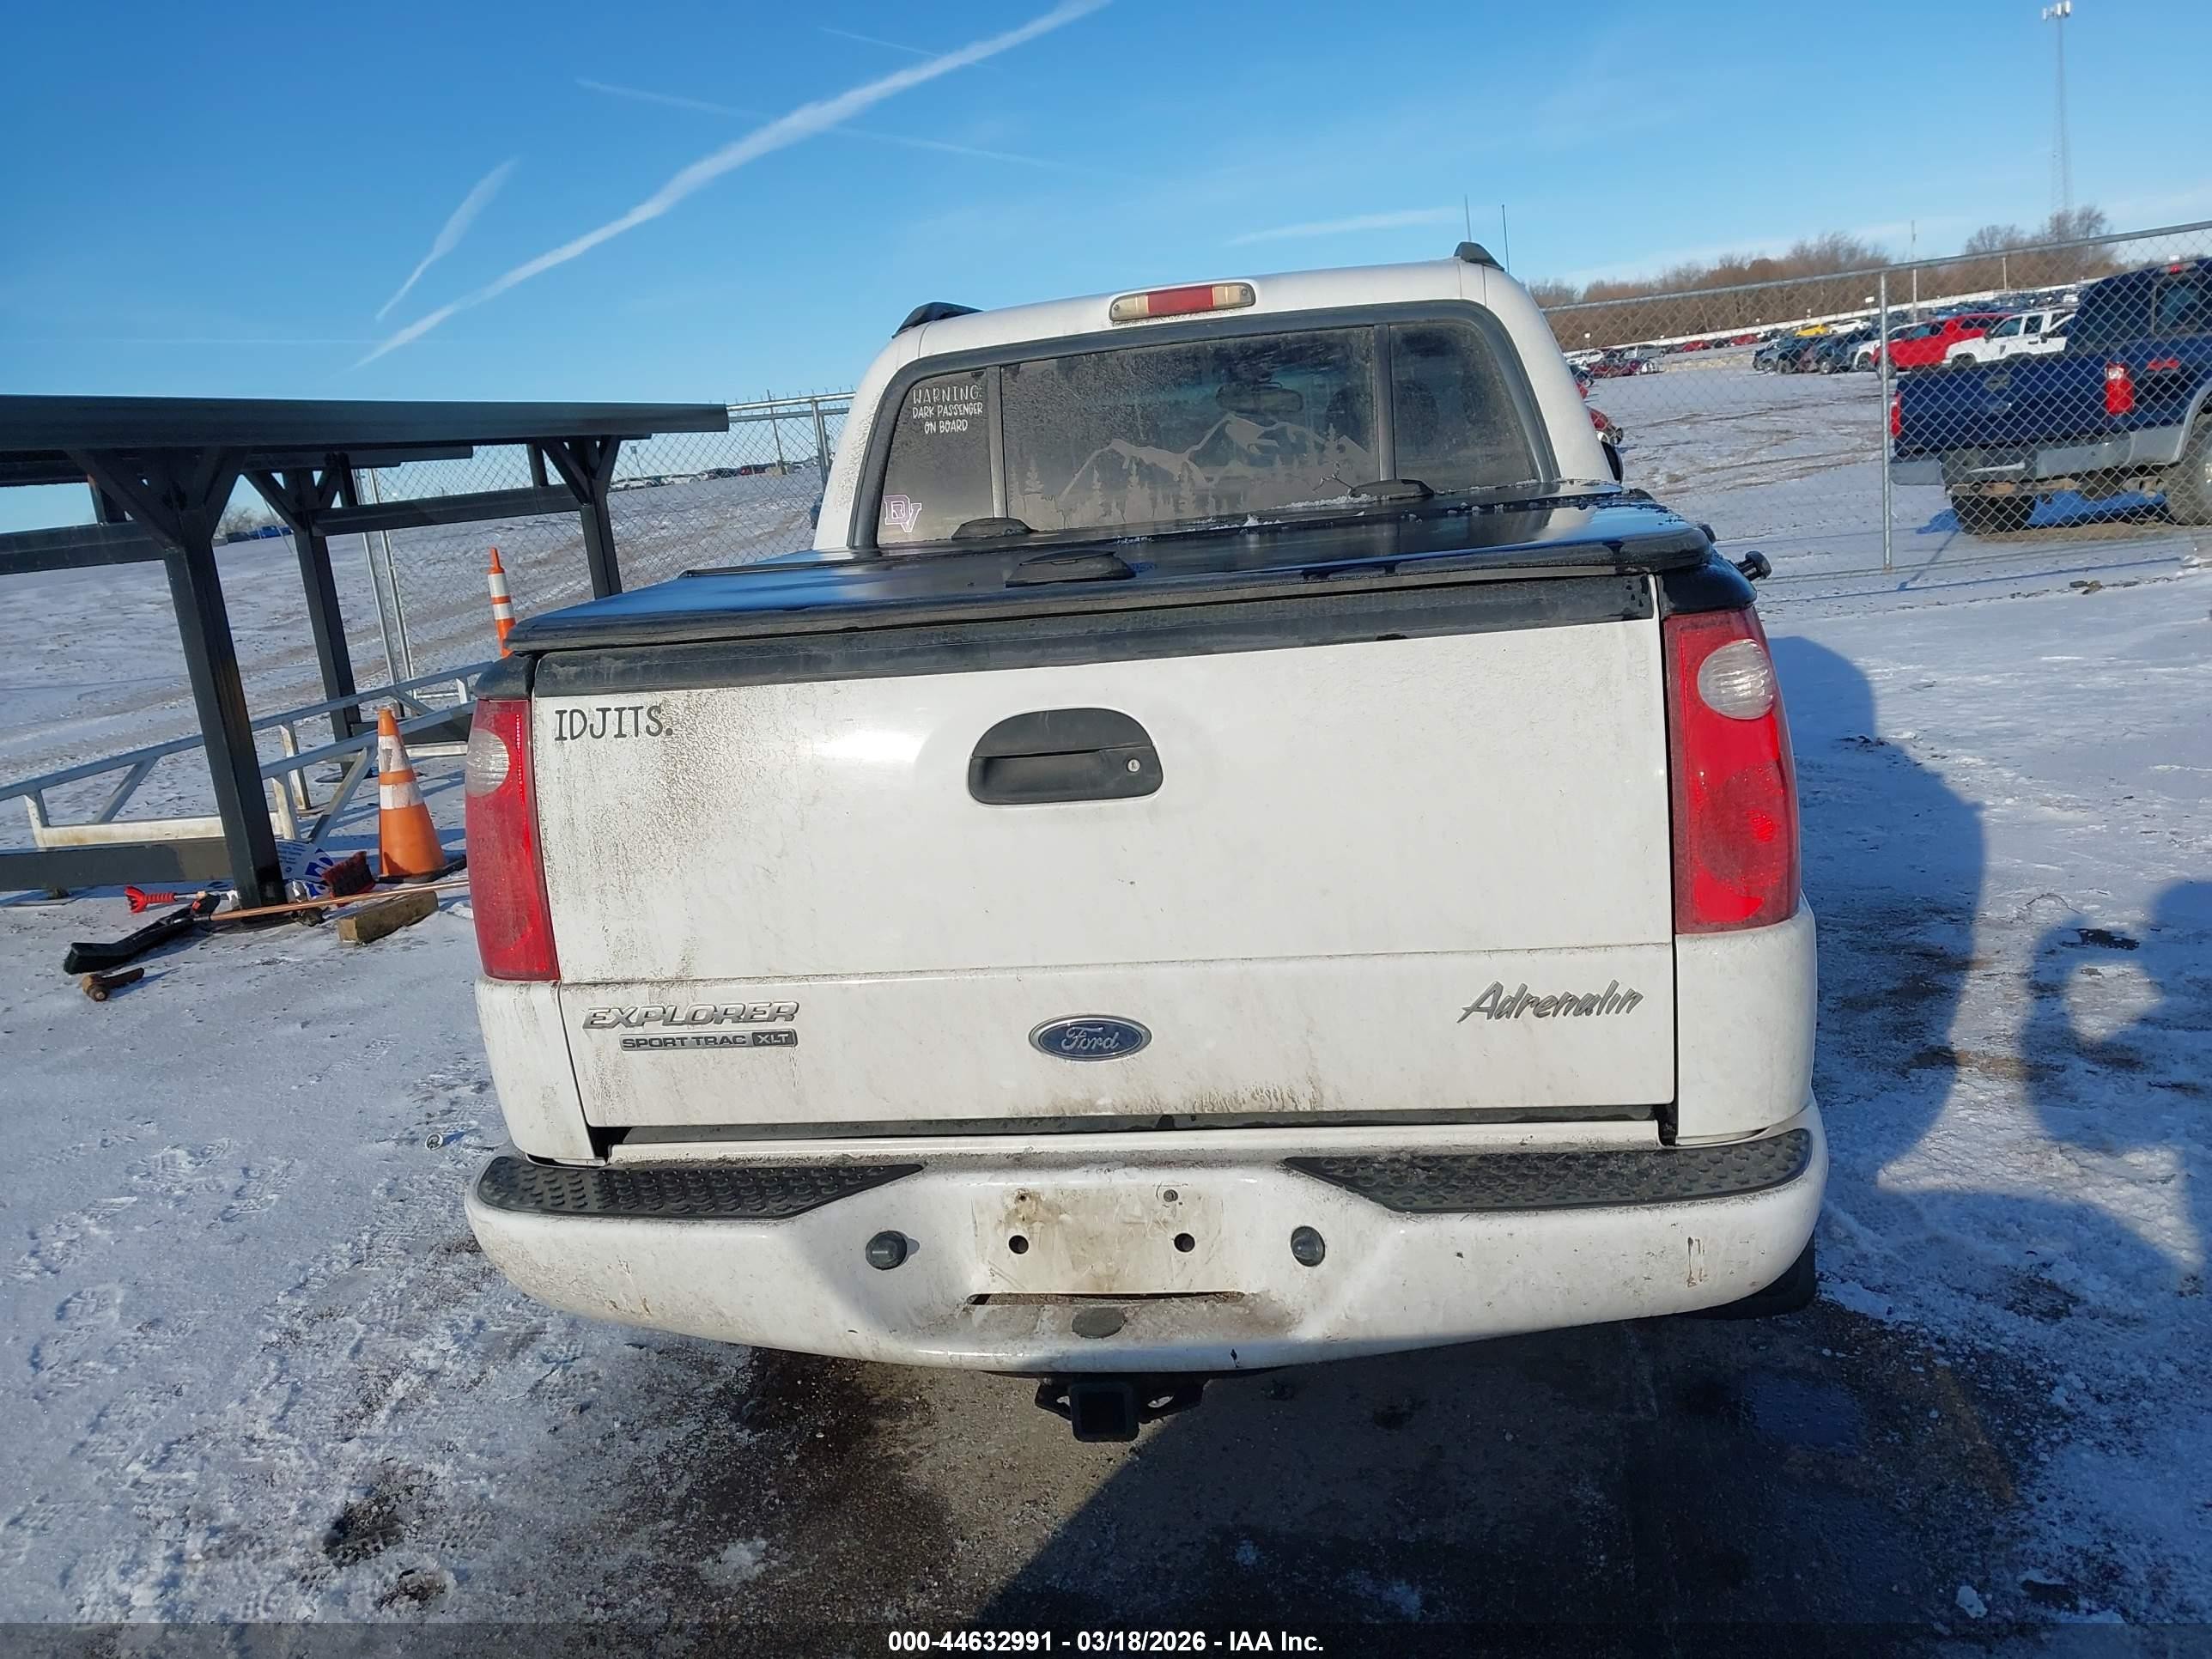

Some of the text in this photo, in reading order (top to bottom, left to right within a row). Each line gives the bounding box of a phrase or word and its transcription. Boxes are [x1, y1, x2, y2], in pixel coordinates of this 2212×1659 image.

[912, 402, 983, 419] DARK PASSENGER
[924, 419, 968, 434] ON BOARD
[555, 705, 673, 741] IDJITS.
[1456, 980, 1644, 1024] Adrenalin
[582, 1001, 799, 1029] EXPLORER
[622, 1032, 791, 1049] SPORT TRAC XLT
[1060, 1026, 1120, 1050] Ford
